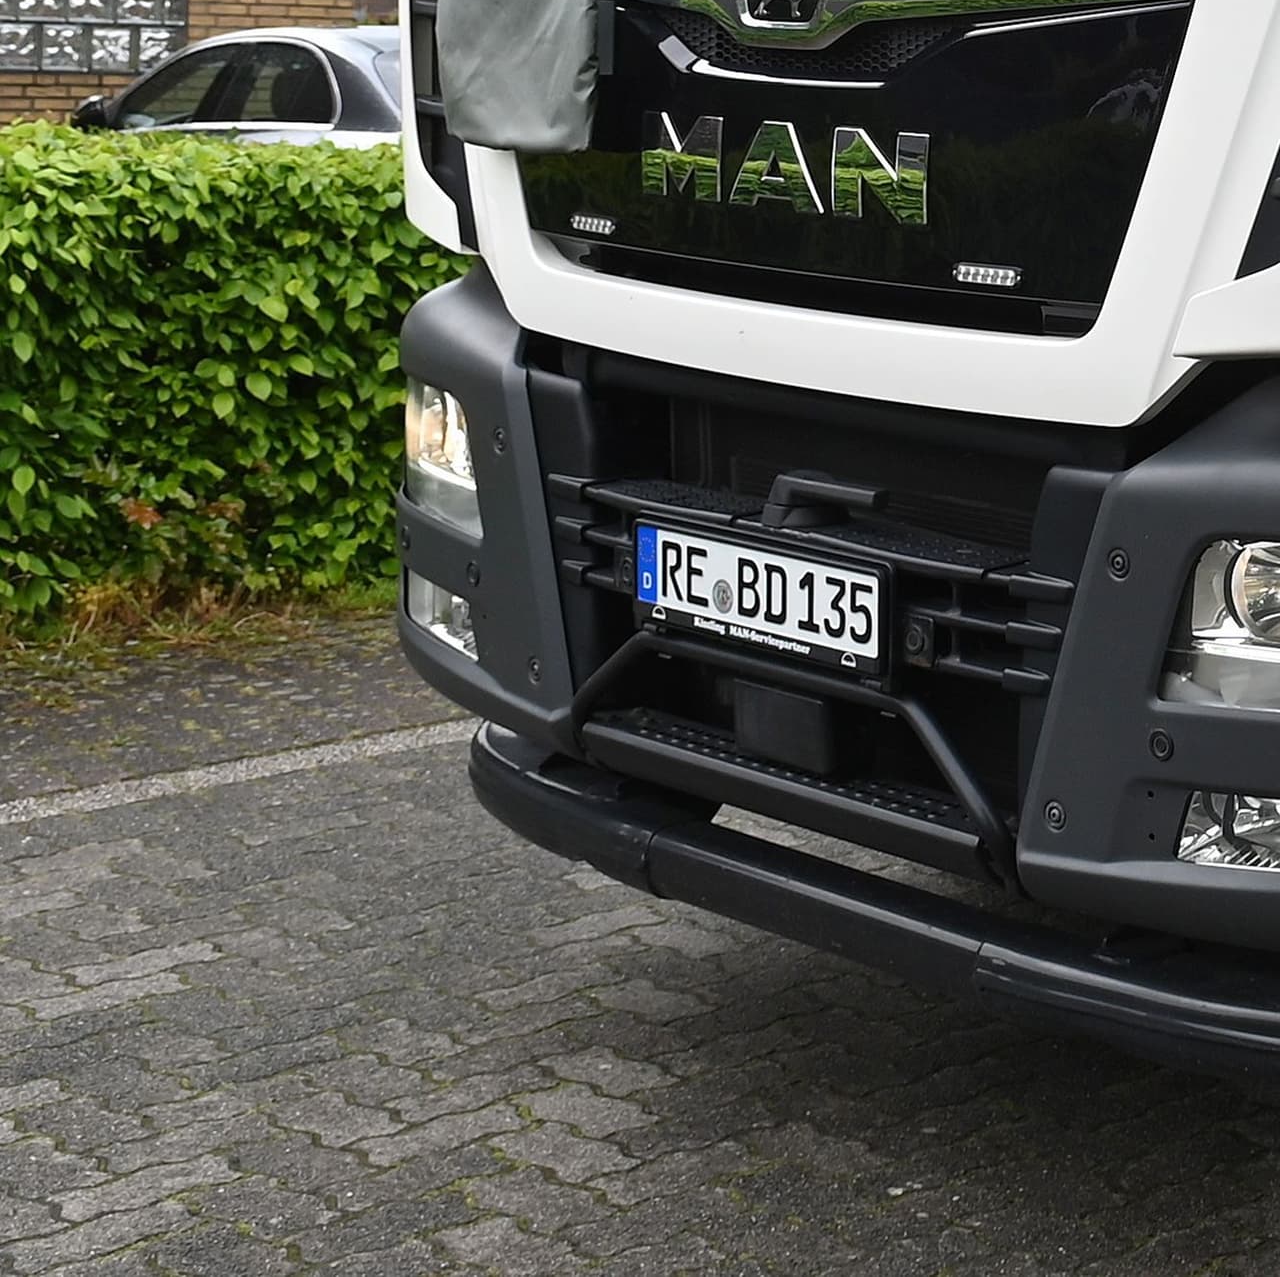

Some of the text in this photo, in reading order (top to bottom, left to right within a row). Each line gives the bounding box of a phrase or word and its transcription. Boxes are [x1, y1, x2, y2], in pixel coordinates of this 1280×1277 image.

[641, 110, 930, 224] MAN
[643, 571, 652, 590] D
[661, 539, 709, 608] RE
